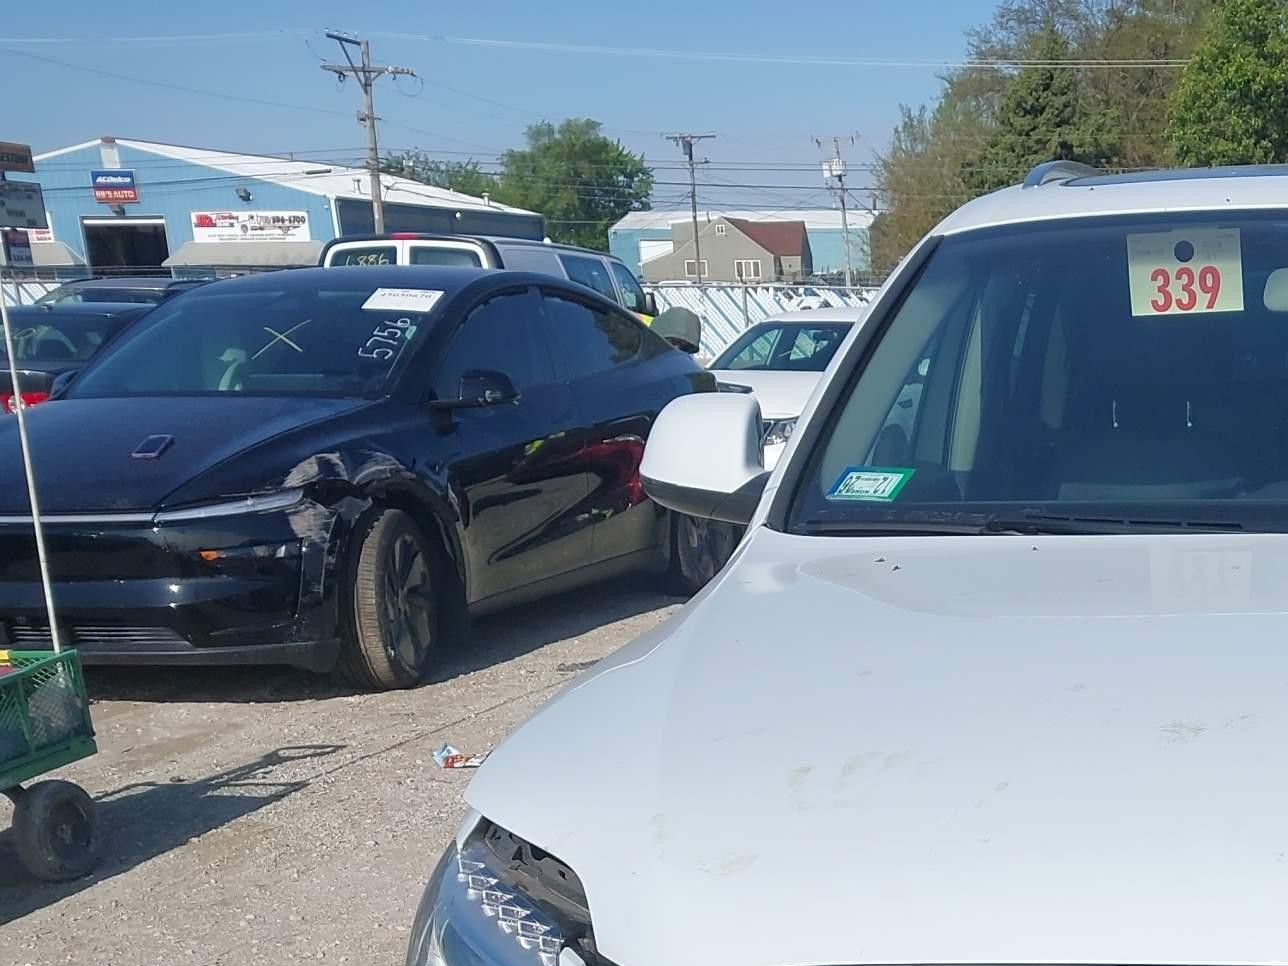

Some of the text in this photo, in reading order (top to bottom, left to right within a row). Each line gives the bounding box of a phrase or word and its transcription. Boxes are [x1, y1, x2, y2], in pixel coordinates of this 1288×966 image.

[113, 190, 134, 198] AUTO
[1150, 265, 1222, 313] 339
[358, 317, 411, 360] 5756
